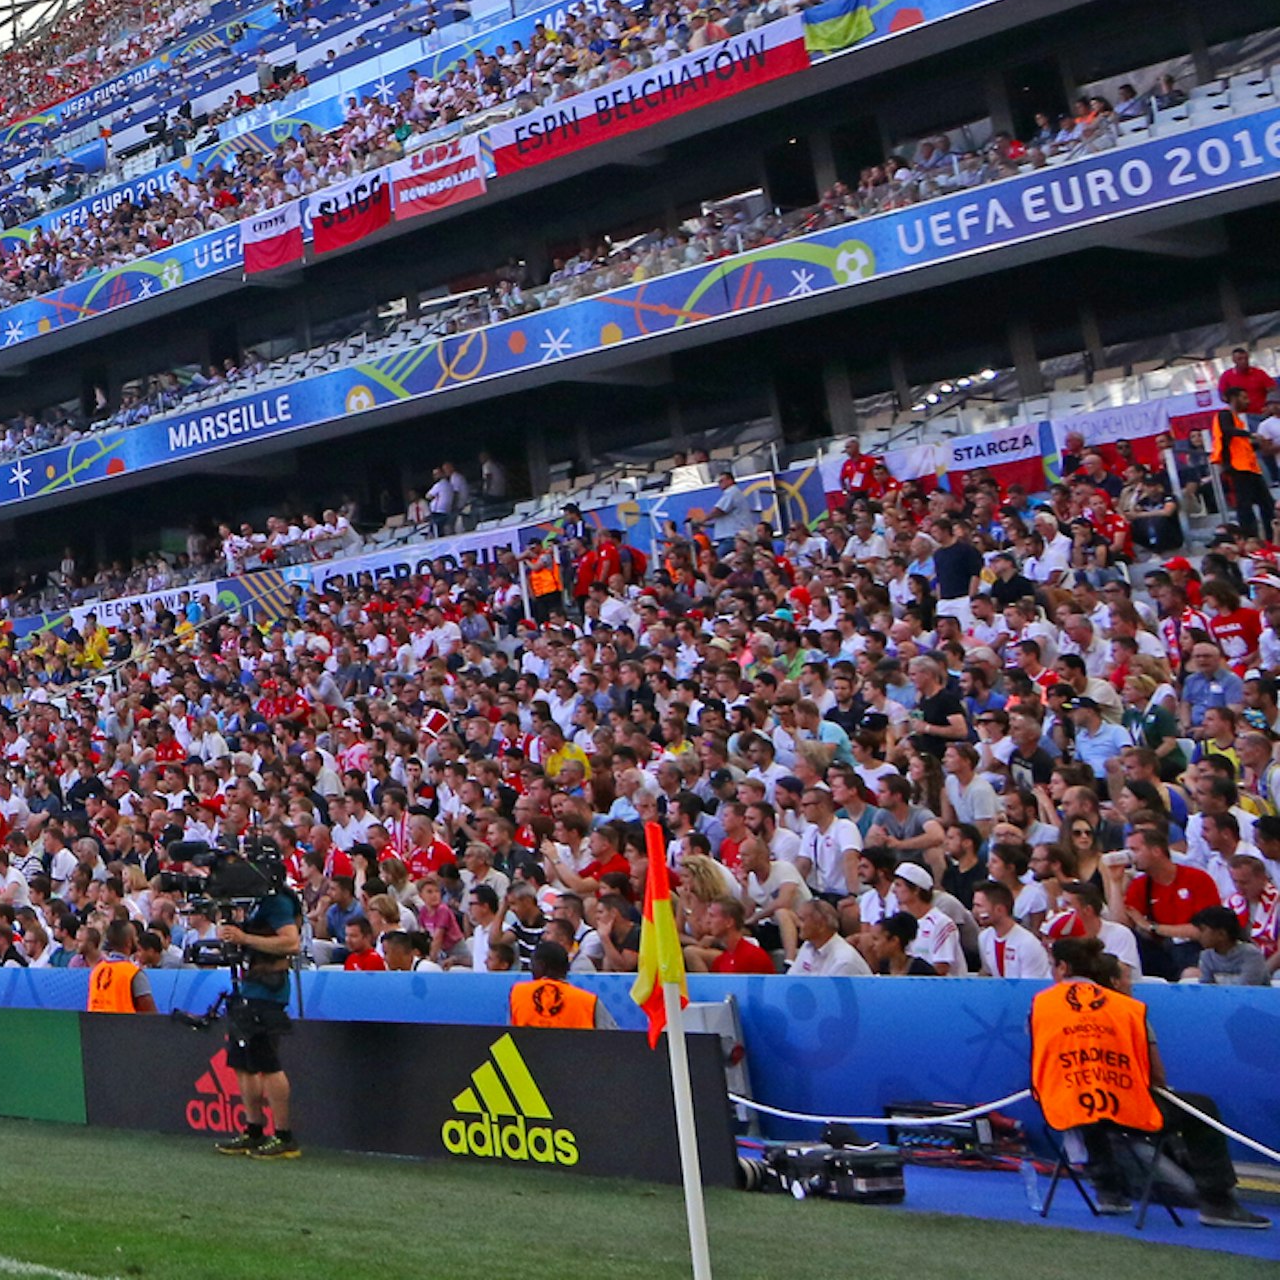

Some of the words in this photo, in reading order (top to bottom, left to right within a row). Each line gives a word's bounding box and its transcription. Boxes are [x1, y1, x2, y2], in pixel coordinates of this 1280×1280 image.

[514, 106, 581, 154] ESPN
[595, 34, 767, 121] BEŁCHATÓW
[896, 196, 1014, 255] UEFA
[1021, 159, 1154, 223] EURO
[168, 393, 292, 452] MARSEILLE
[953, 434, 1034, 462] STARCZA
[441, 1111, 580, 1167] adidas
